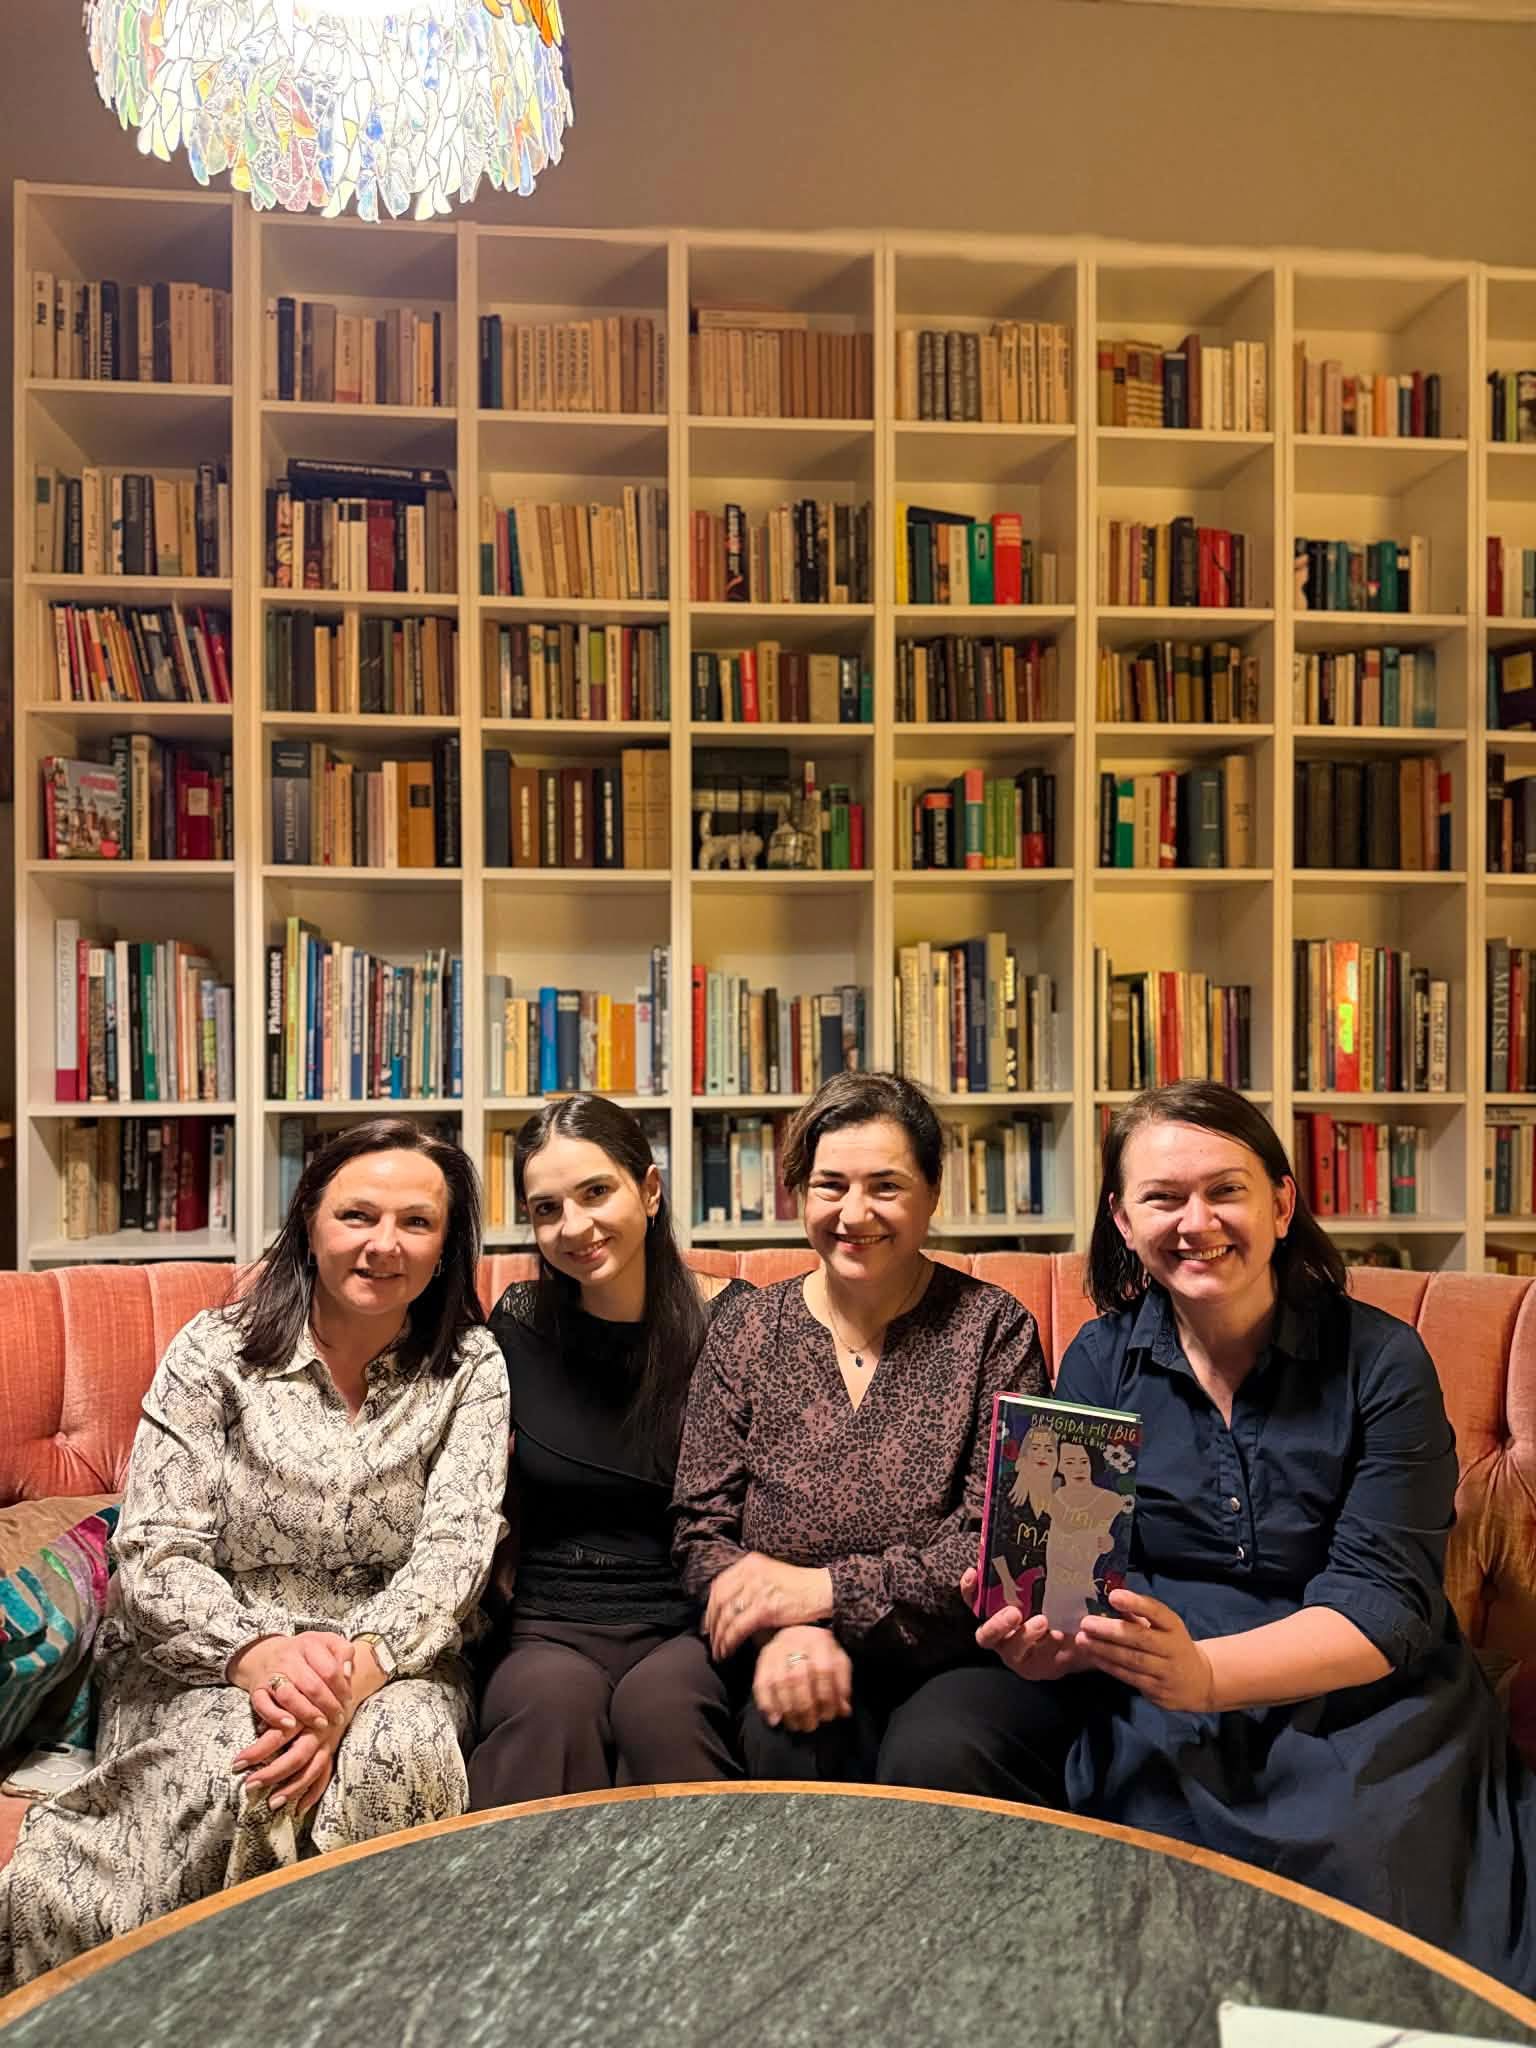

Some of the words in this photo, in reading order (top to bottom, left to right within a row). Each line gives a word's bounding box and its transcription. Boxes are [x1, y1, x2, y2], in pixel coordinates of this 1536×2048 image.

[1492, 971, 1509, 1064] MATISSE
[1031, 1413, 1085, 1433] BRYGIDA
[1089, 1422, 1137, 1441] HELBIG
